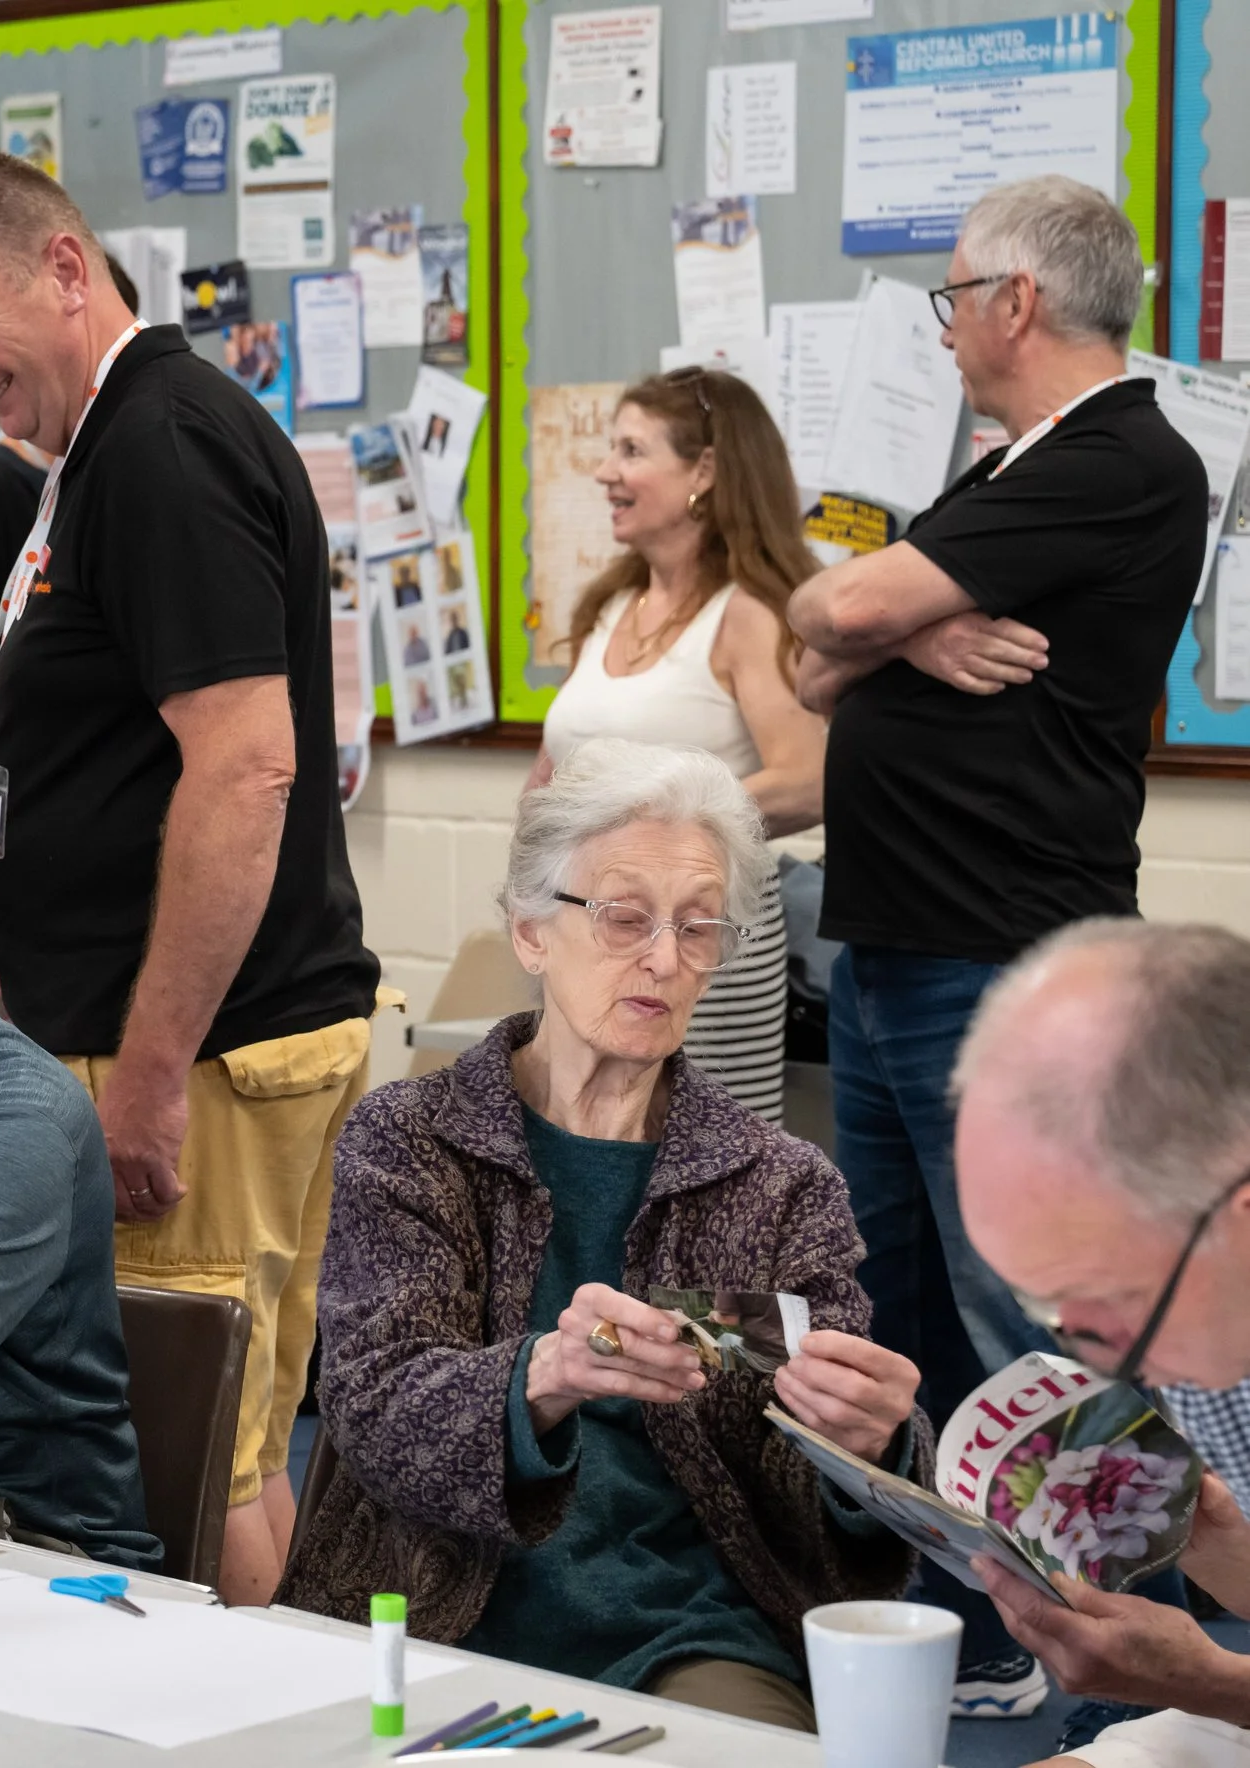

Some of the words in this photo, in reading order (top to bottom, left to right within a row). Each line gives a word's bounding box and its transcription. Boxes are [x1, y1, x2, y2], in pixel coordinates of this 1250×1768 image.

[896, 35, 965, 57] CENTRAL
[967, 29, 1026, 50] UNITED
[897, 49, 979, 73] REFORMED
[981, 43, 1052, 66] CHURCH
[245, 101, 311, 119] DONATE
